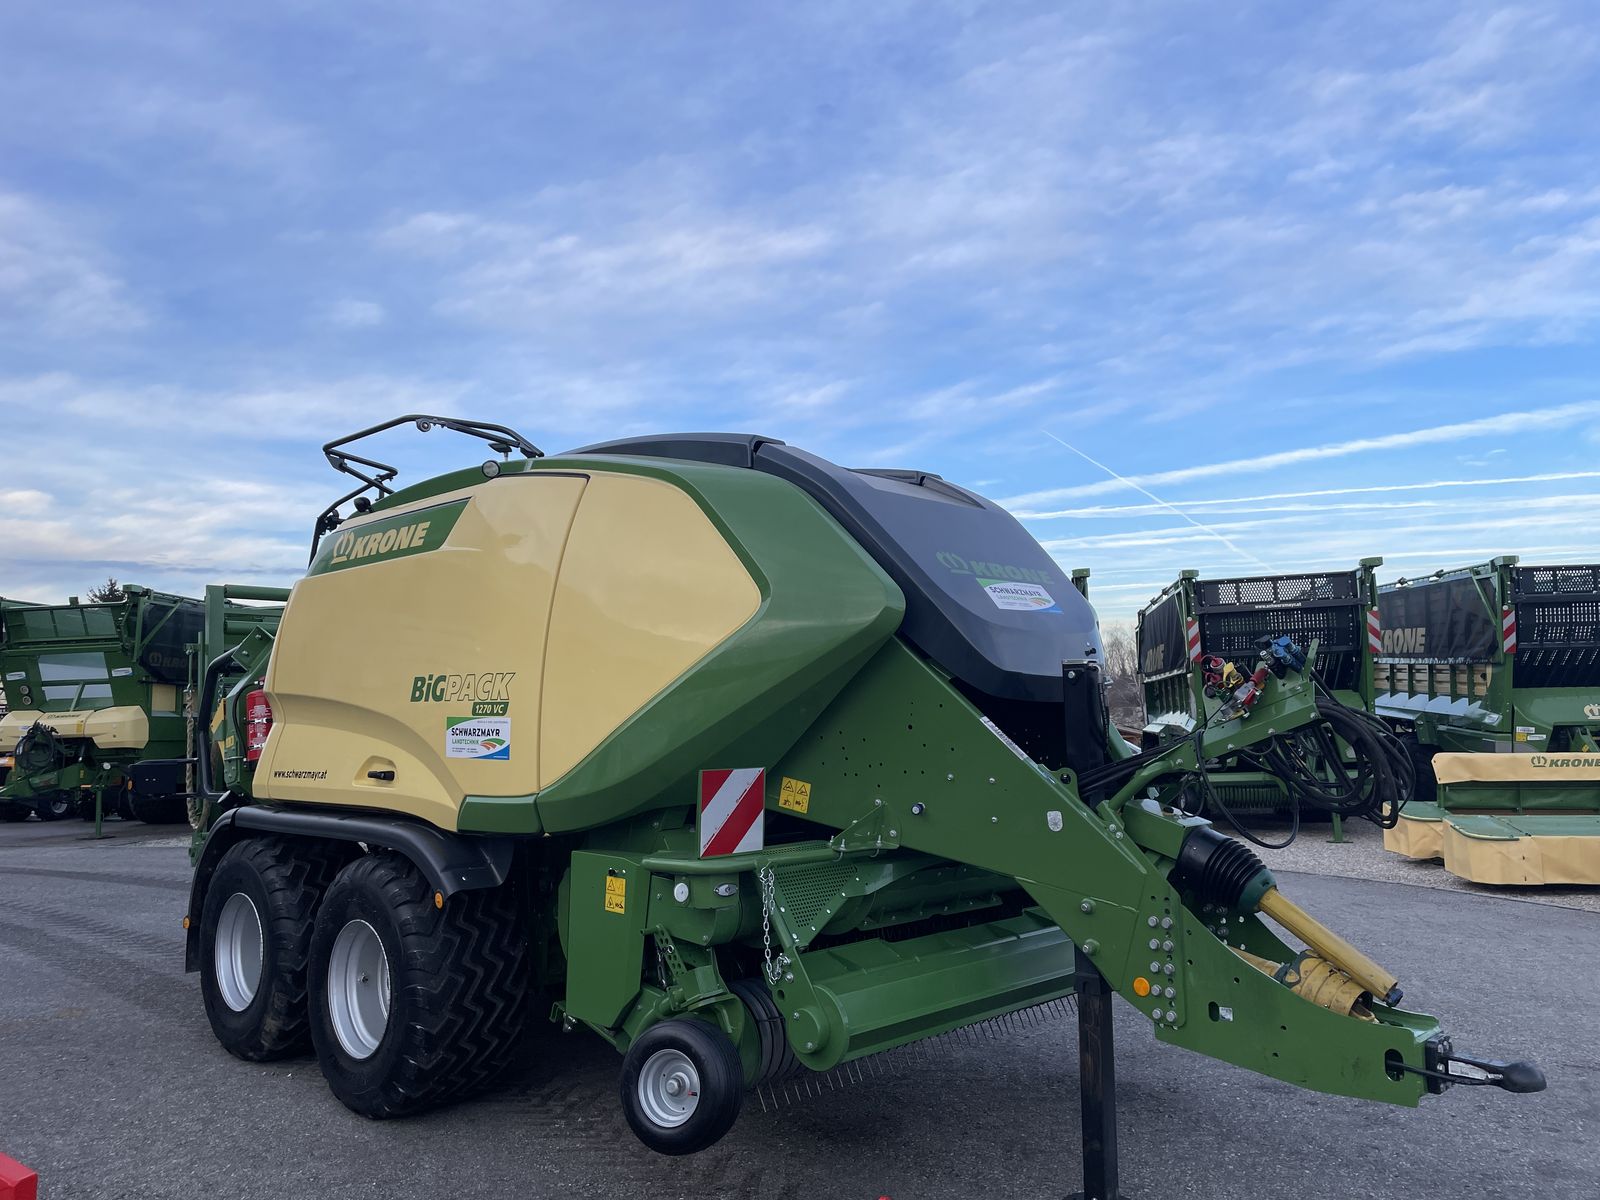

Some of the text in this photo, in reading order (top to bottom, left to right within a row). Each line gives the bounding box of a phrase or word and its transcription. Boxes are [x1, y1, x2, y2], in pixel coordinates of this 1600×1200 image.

[349, 521, 431, 560] KRONE
[968, 560, 1055, 585] KRONE
[988, 585, 1042, 597] SCHWARZMAYR
[475, 704, 505, 714] 1270 VC
[451, 727, 501, 737] SCHWARZMAYR
[1548, 758, 1600, 768] KRONE
[273, 768, 328, 781] www.schwarzmayr.at
